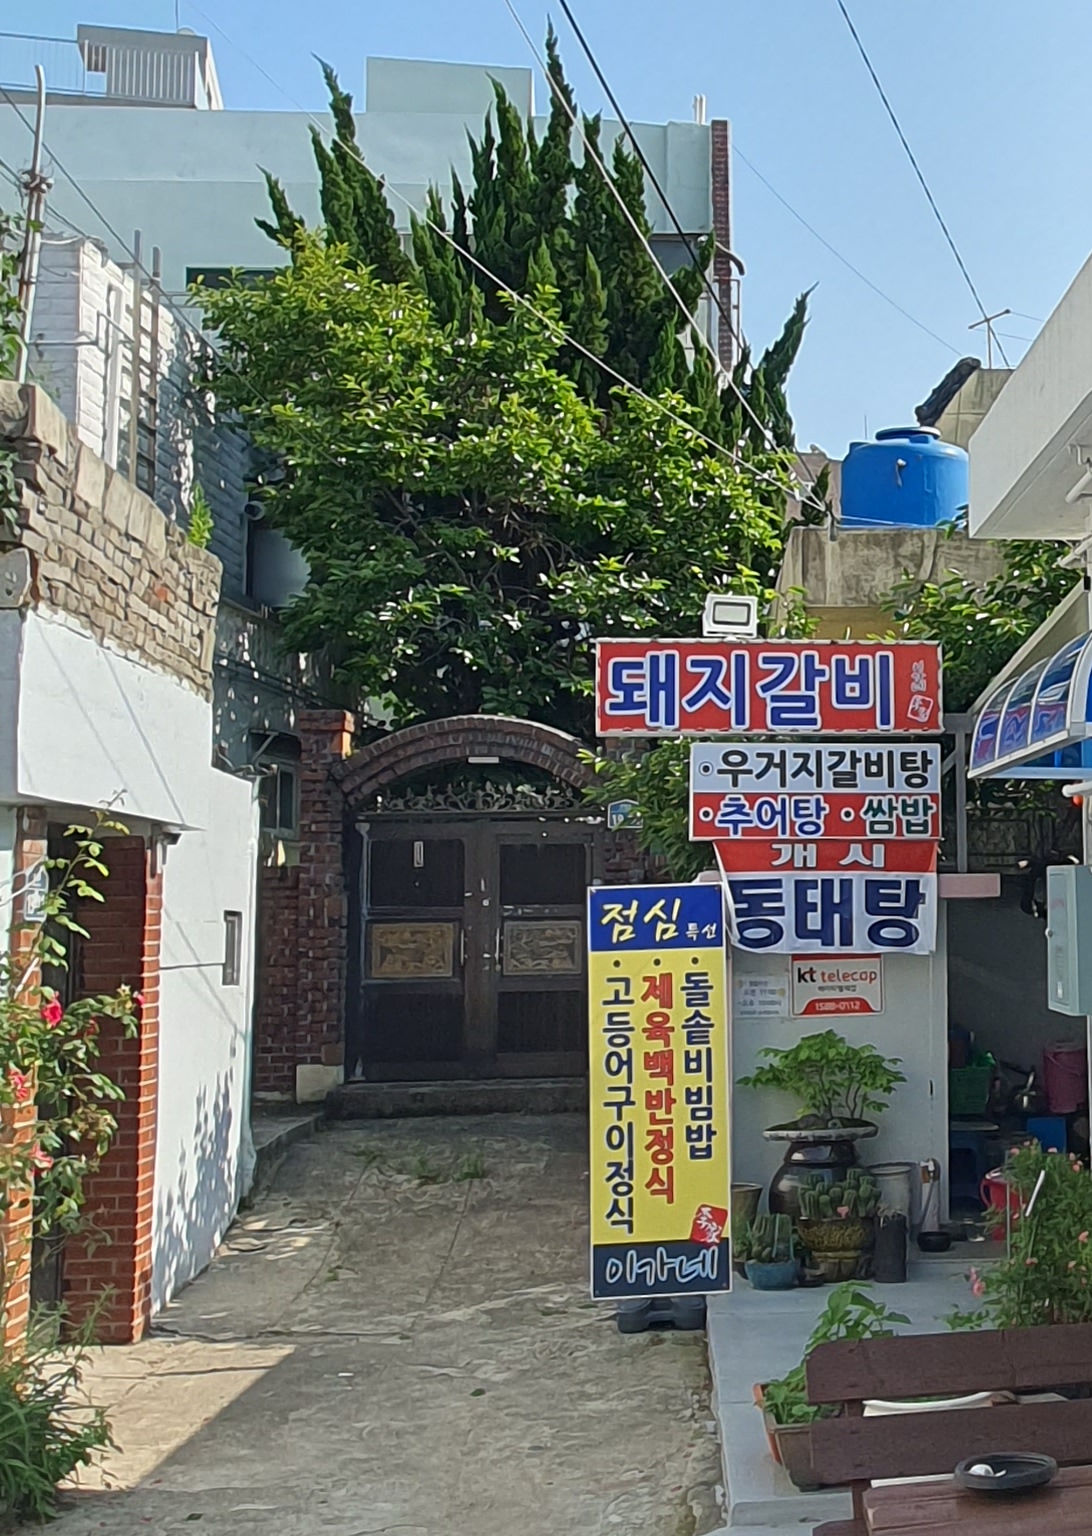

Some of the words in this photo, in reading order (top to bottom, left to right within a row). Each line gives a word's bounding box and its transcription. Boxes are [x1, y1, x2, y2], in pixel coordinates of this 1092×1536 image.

[604, 648, 895, 731] 돼지갈비
[715, 748, 935, 790] 우거지갈비탕
[715, 794, 829, 838] 추어탕
[861, 794, 935, 838] 쌈밥
[600, 896, 682, 944] 점심
[728, 876, 927, 949] 동태탕
[797, 966, 817, 984] kt
[640, 972, 677, 1205] 제육백반정식
[679, 970, 717, 1161] 돌솥비빔밥
[601, 975, 637, 1235] 고등어구이정식
